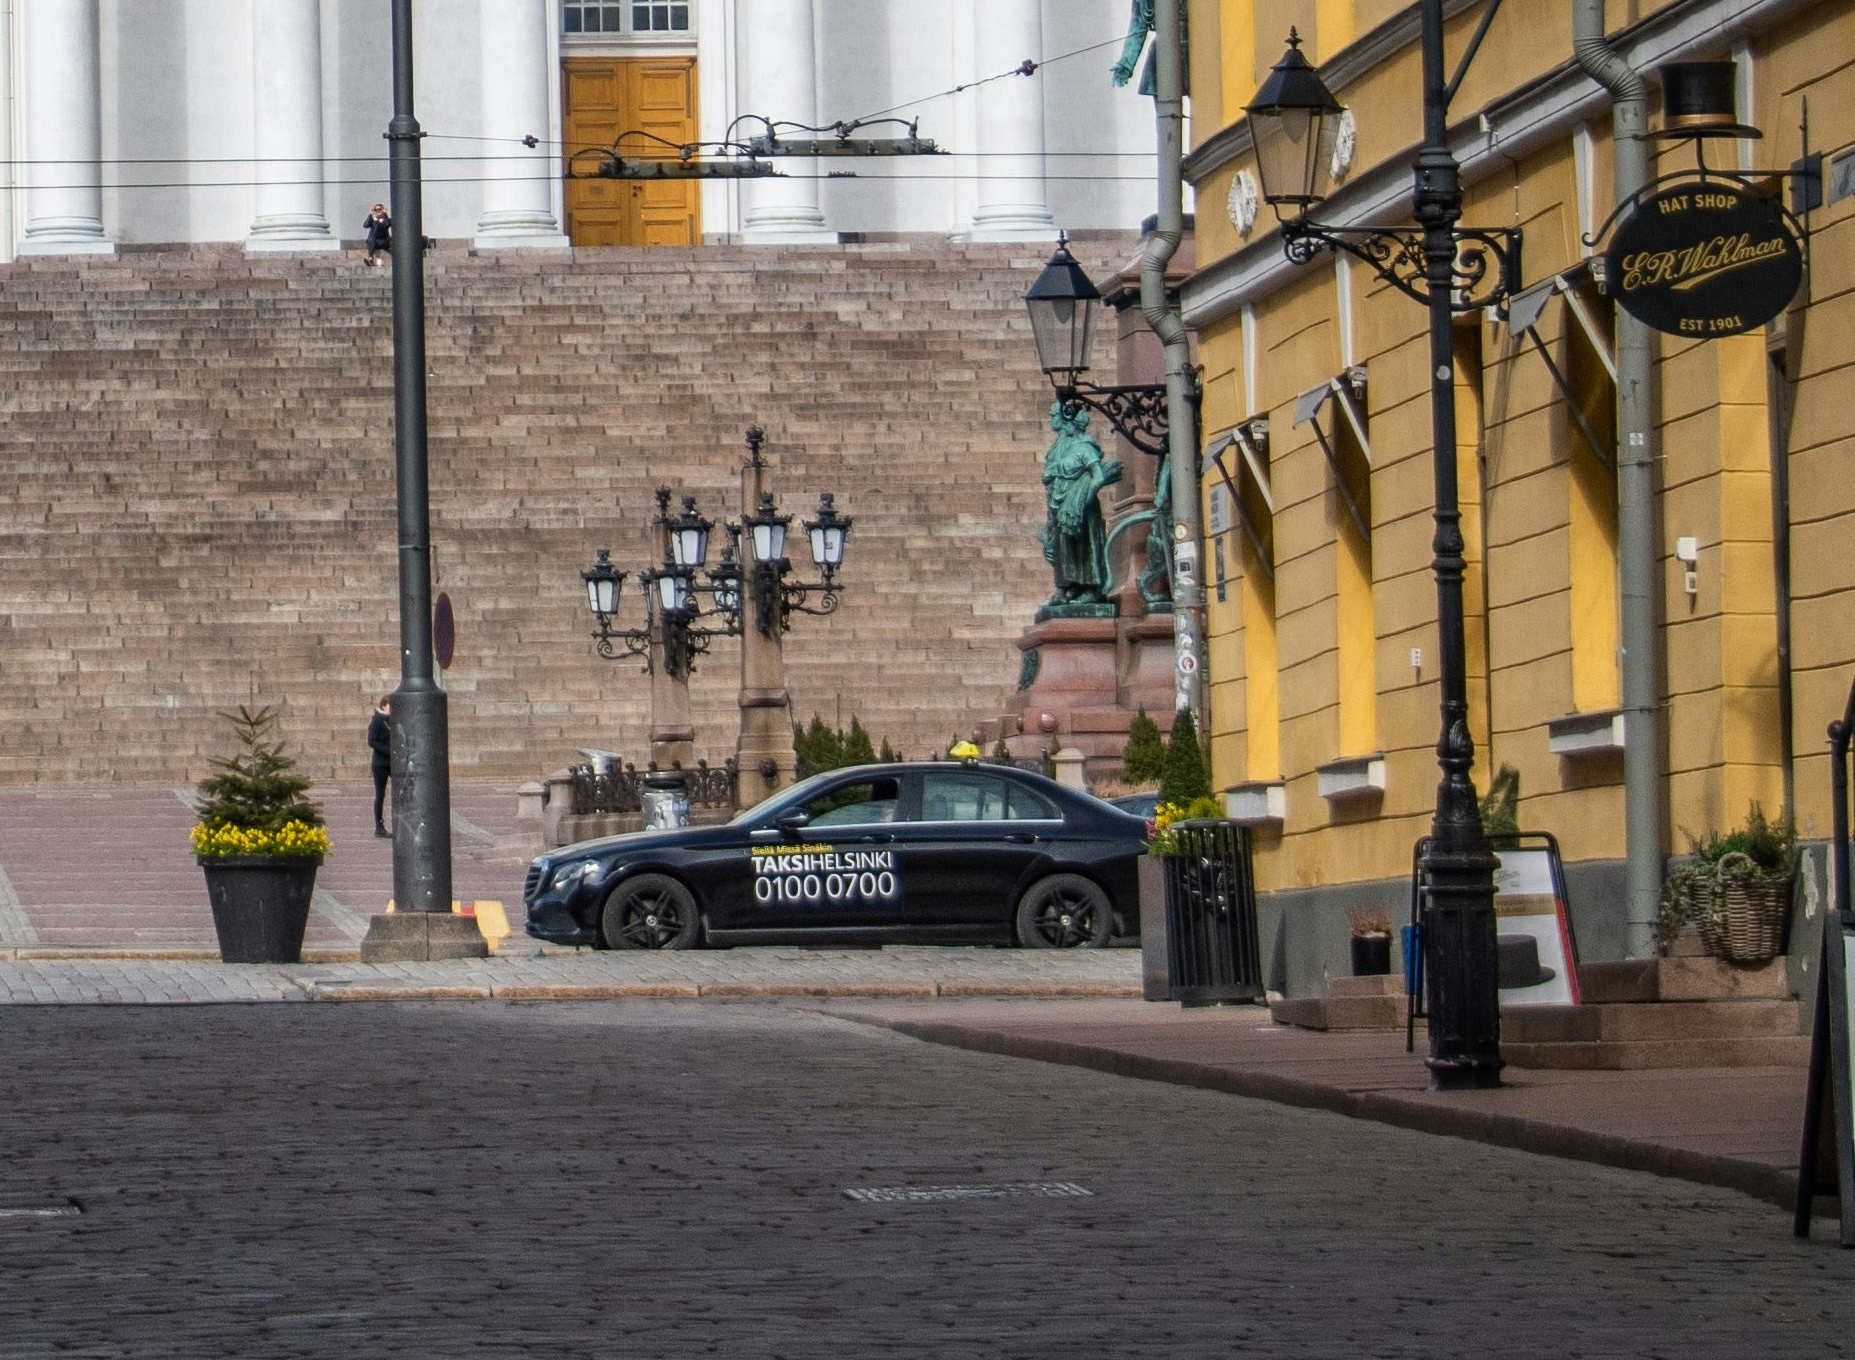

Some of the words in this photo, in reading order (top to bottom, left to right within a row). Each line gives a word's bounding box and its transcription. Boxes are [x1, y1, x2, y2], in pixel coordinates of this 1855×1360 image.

[1658, 195, 1688, 214] HAT
[1696, 194, 1737, 209] SHOP
[1679, 318, 1703, 331] EST
[1709, 315, 1743, 331] 1901
[751, 851, 892, 873] TAKSIHELSINKI
[755, 875, 821, 901] 0100
[826, 871, 895, 898] 0700
